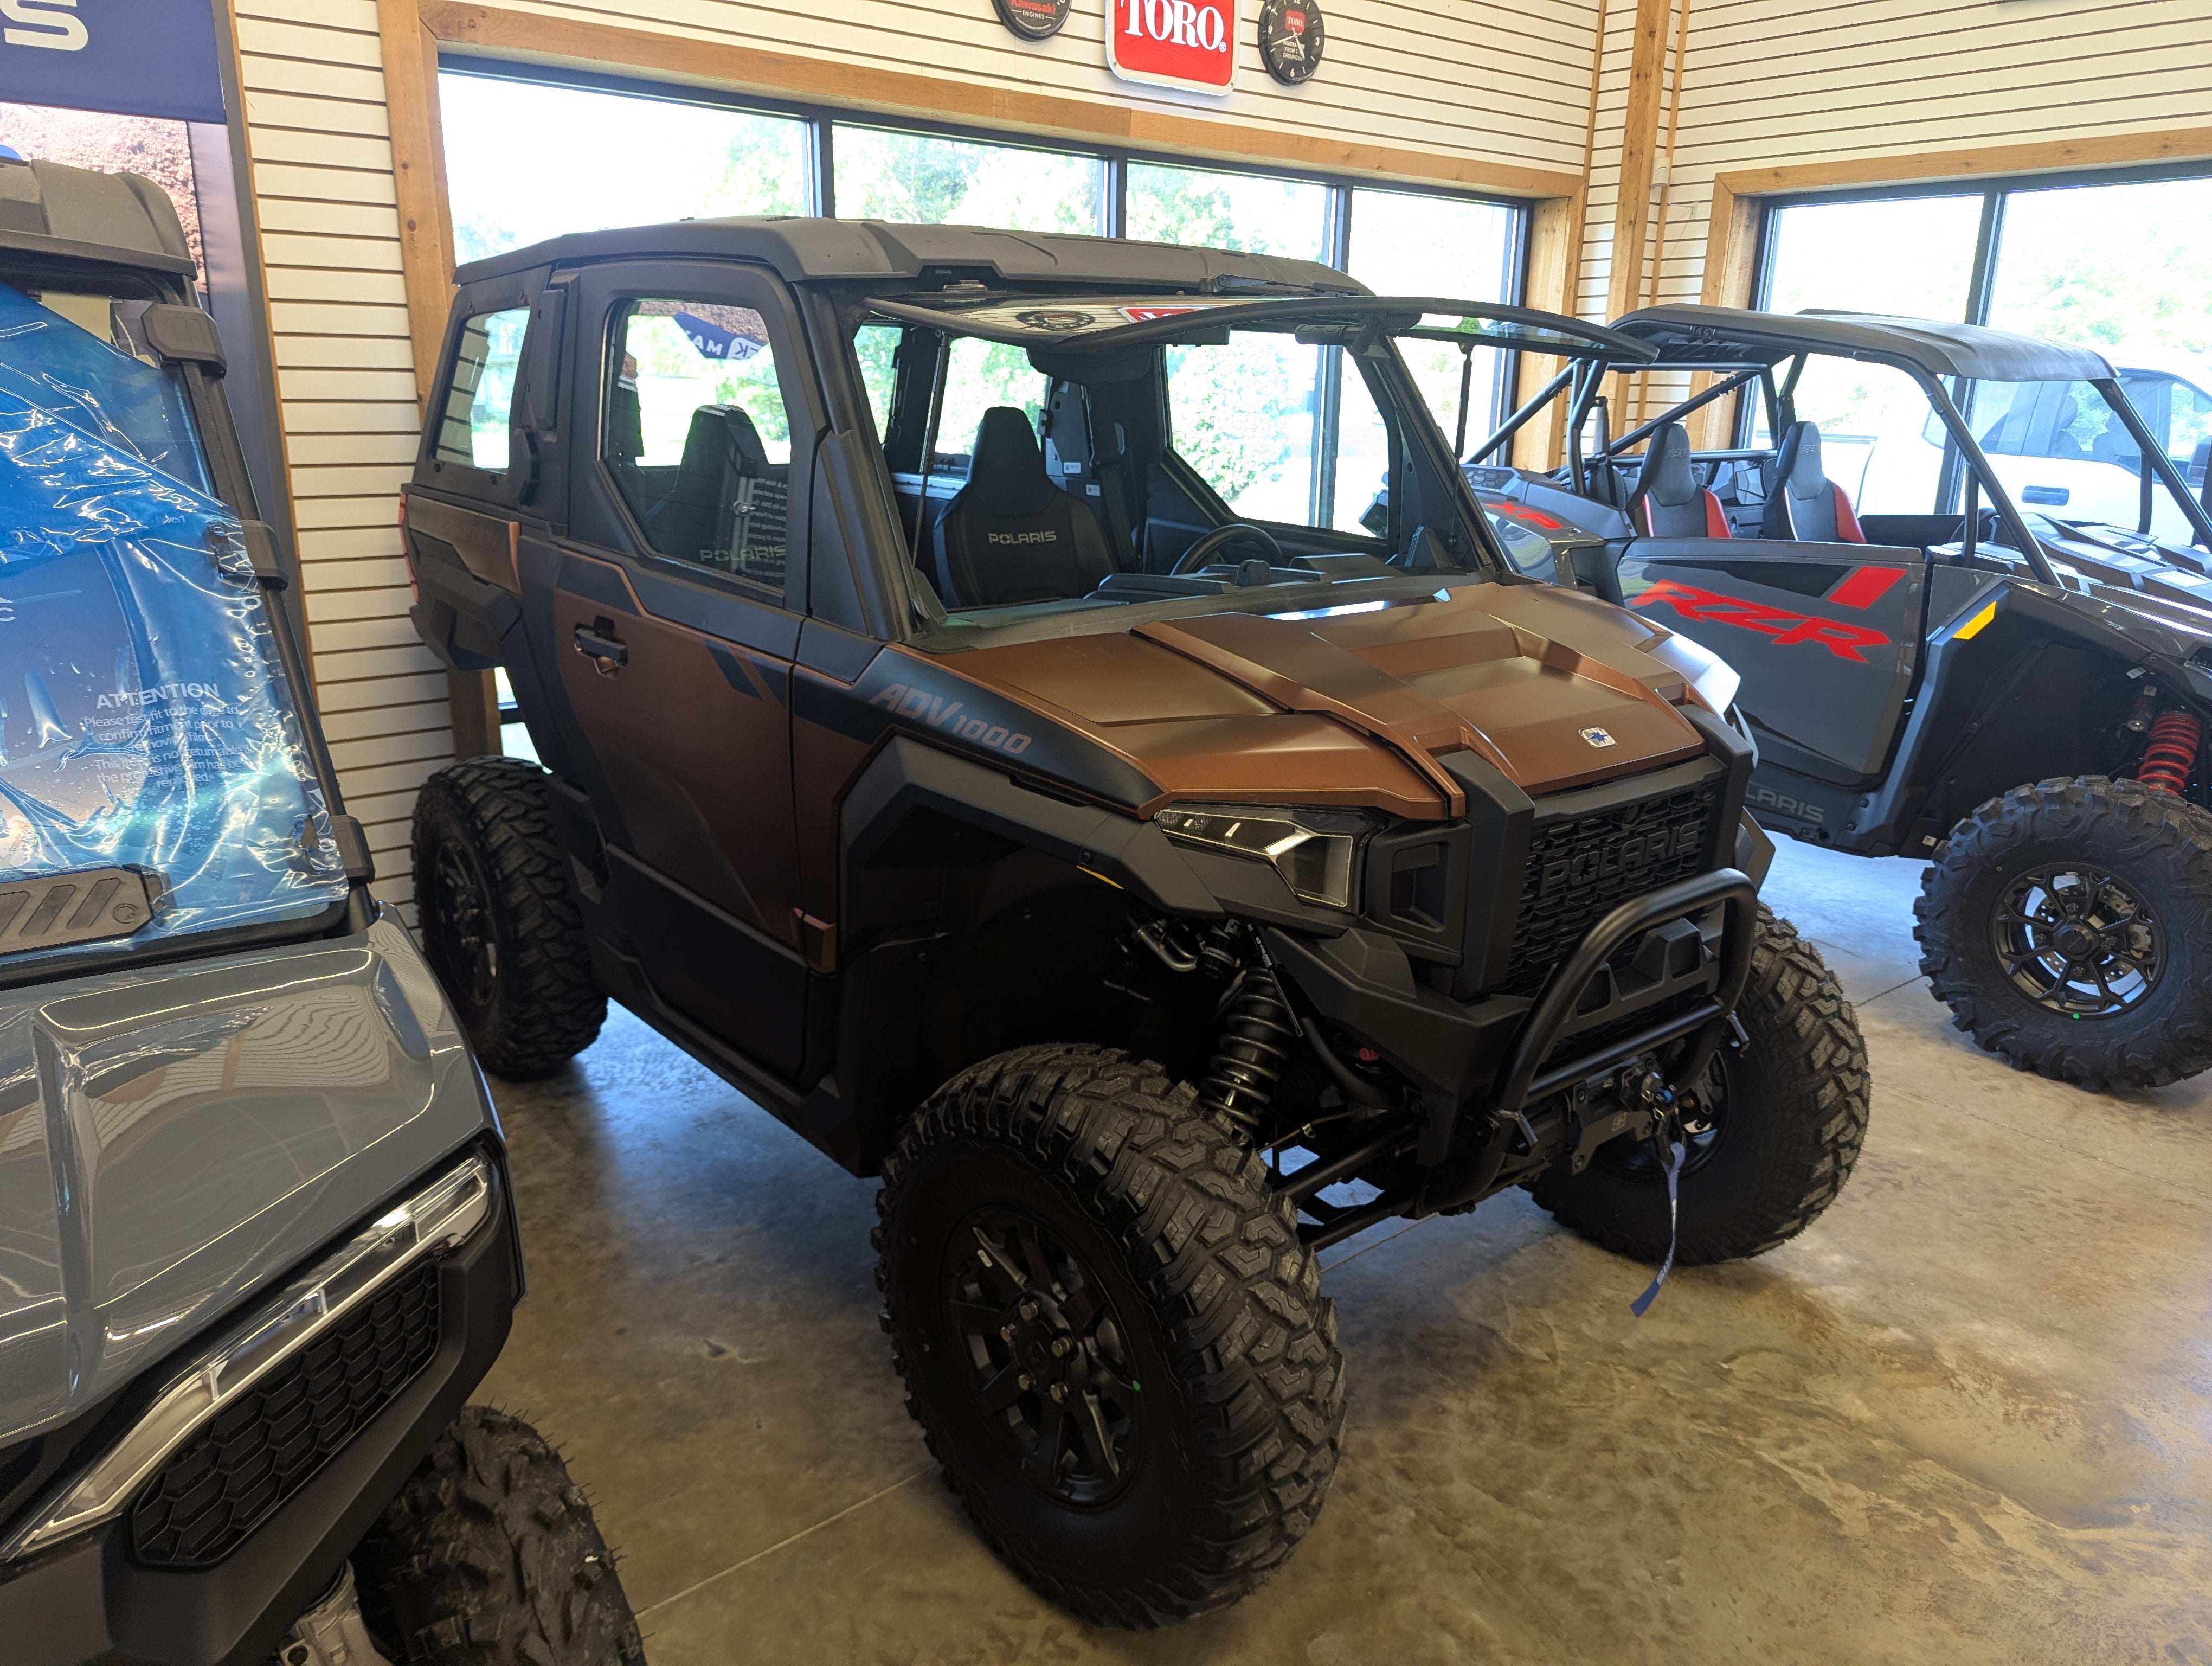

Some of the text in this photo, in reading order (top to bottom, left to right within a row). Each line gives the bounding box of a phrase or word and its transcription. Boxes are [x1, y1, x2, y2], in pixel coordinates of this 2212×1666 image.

[1022, 10, 1045, 20] ENGINES
[1315, 37, 1320, 46] 3
[1290, 68, 1295, 77] 6
[988, 530, 1057, 544] POLARIS
[699, 544, 786, 561] POLARIS
[1629, 578, 1892, 664] RZR
[96, 683, 220, 709] ATTENTION
[84, 716, 124, 727] Please
[125, 714, 148, 725] test
[151, 710, 164, 721] fit
[164, 708, 177, 717] to
[221, 720, 233, 728] to
[869, 683, 1032, 754] ADV 1000
[93, 758, 120, 770] This
[97, 772, 119, 783] the
[1745, 781, 1825, 823] LARIS
[1539, 819, 1701, 896] POLARIS
